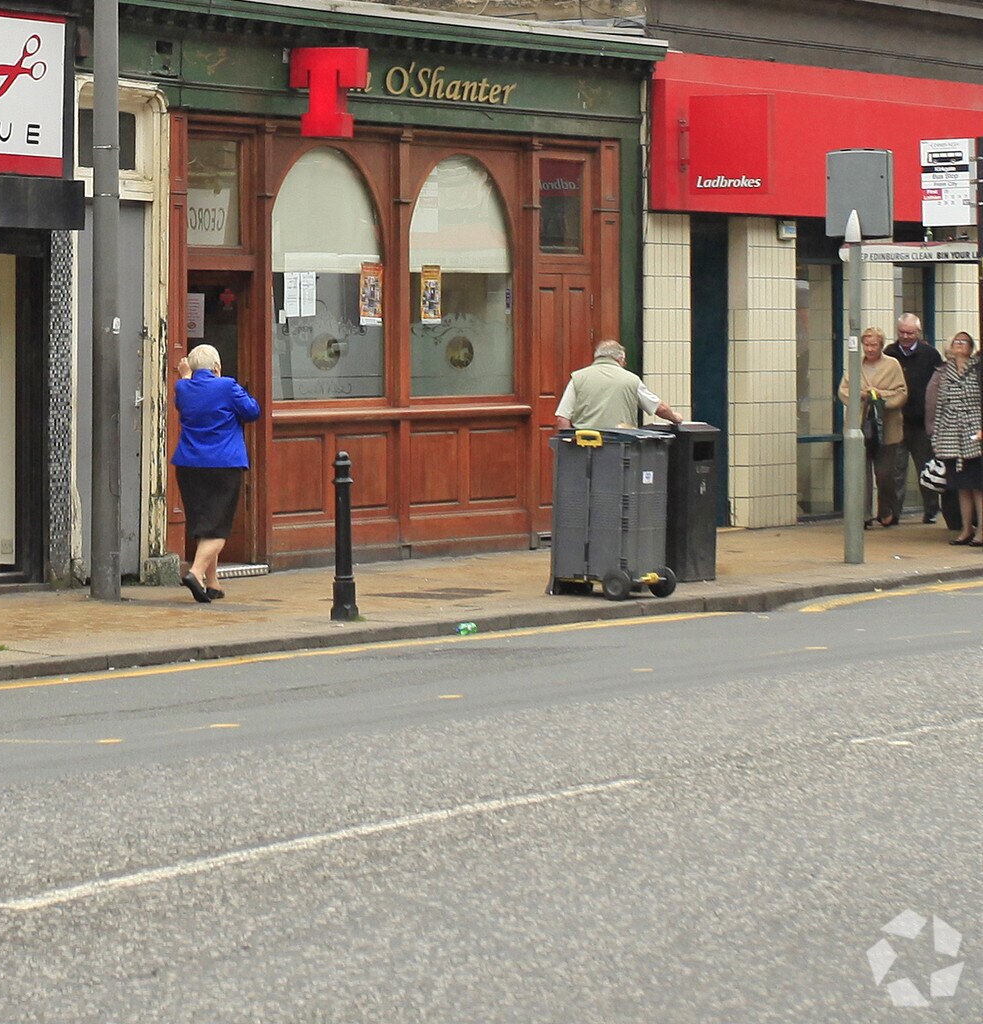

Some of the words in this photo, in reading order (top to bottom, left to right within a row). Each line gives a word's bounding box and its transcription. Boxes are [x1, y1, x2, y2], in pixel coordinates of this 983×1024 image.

[385, 61, 517, 105] O'Shanter
[696, 175, 762, 188] Ladbrokes
[870, 252, 910, 261] EDINBURGH
[911, 251, 933, 260] CLEAN
[937, 251, 949, 260] BIN
[950, 250, 970, 259] YOUR
